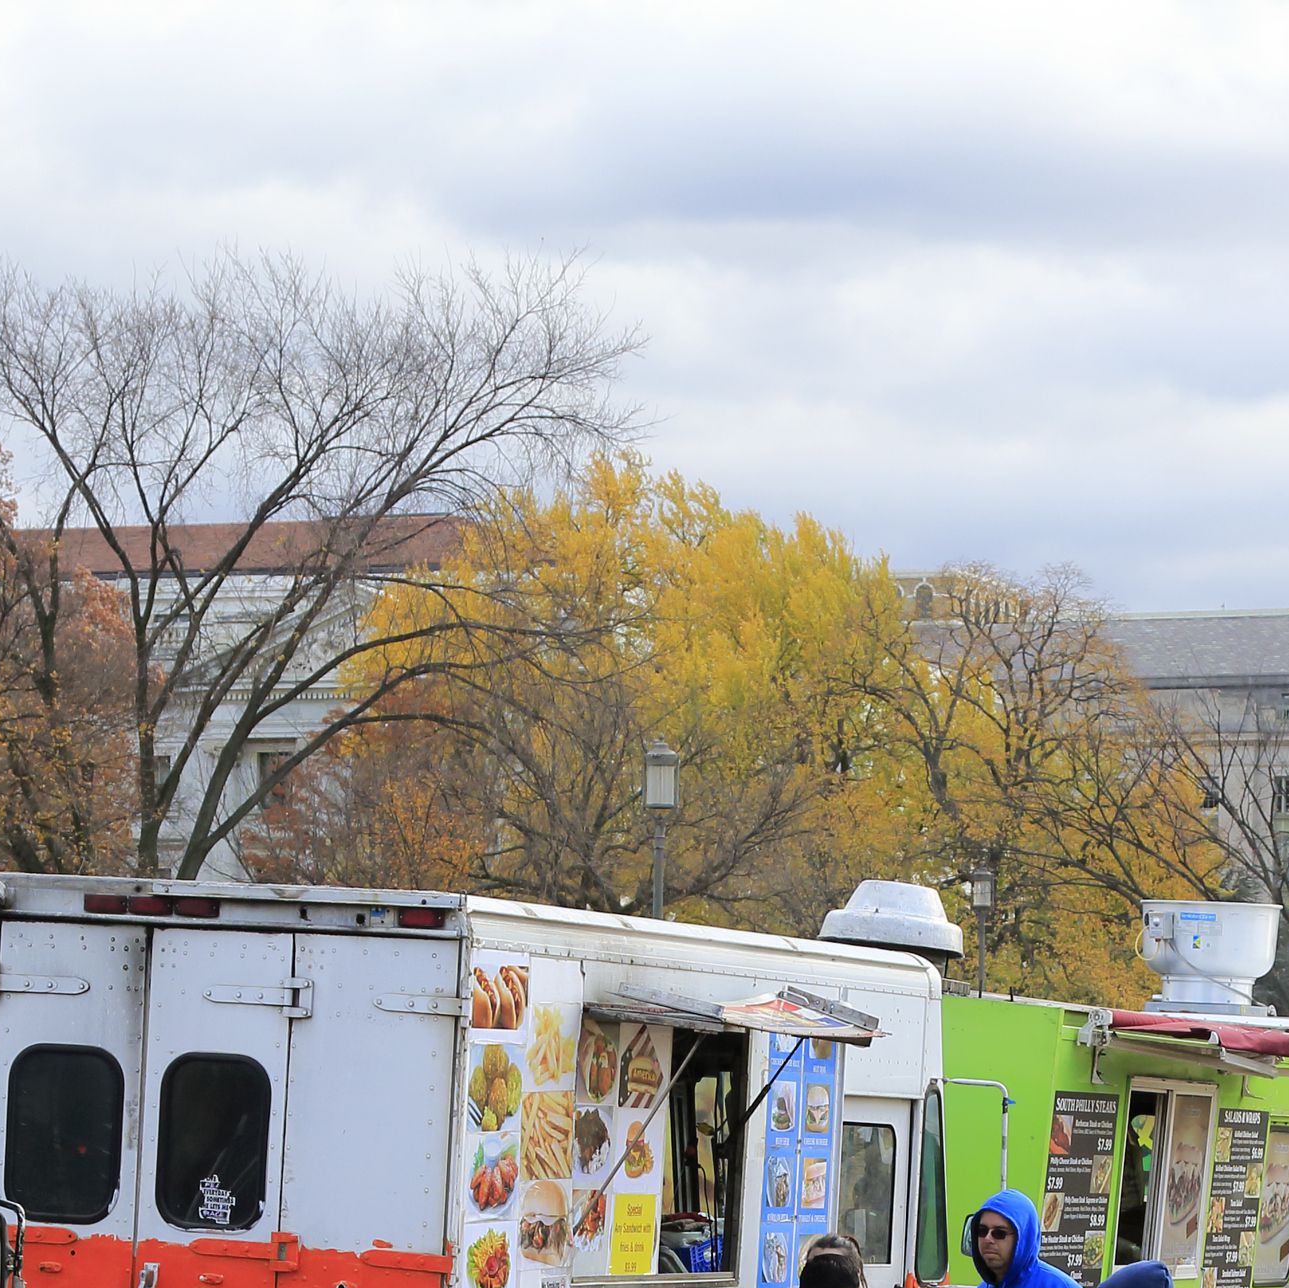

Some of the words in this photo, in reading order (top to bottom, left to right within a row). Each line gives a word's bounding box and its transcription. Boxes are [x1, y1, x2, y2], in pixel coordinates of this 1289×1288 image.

[1055, 1097, 1076, 1112] SOUTH
[1076, 1098, 1095, 1113] PHILLY
[1095, 1100, 1116, 1114] STEAKS
[1224, 1110, 1242, 1123] SALADS
[1246, 1112, 1261, 1125] WRAPS
[1097, 1137, 1113, 1152] $7.99
[1251, 1147, 1263, 1160] $6.99
[1047, 1176, 1063, 1191] $7.99
[1232, 1181, 1245, 1193] $7.99
[1089, 1213, 1105, 1228] $8.99
[1245, 1216, 1257, 1228] $7.99
[1067, 1253, 1083, 1268] $7.99
[1225, 1251, 1238, 1264] $7.99
